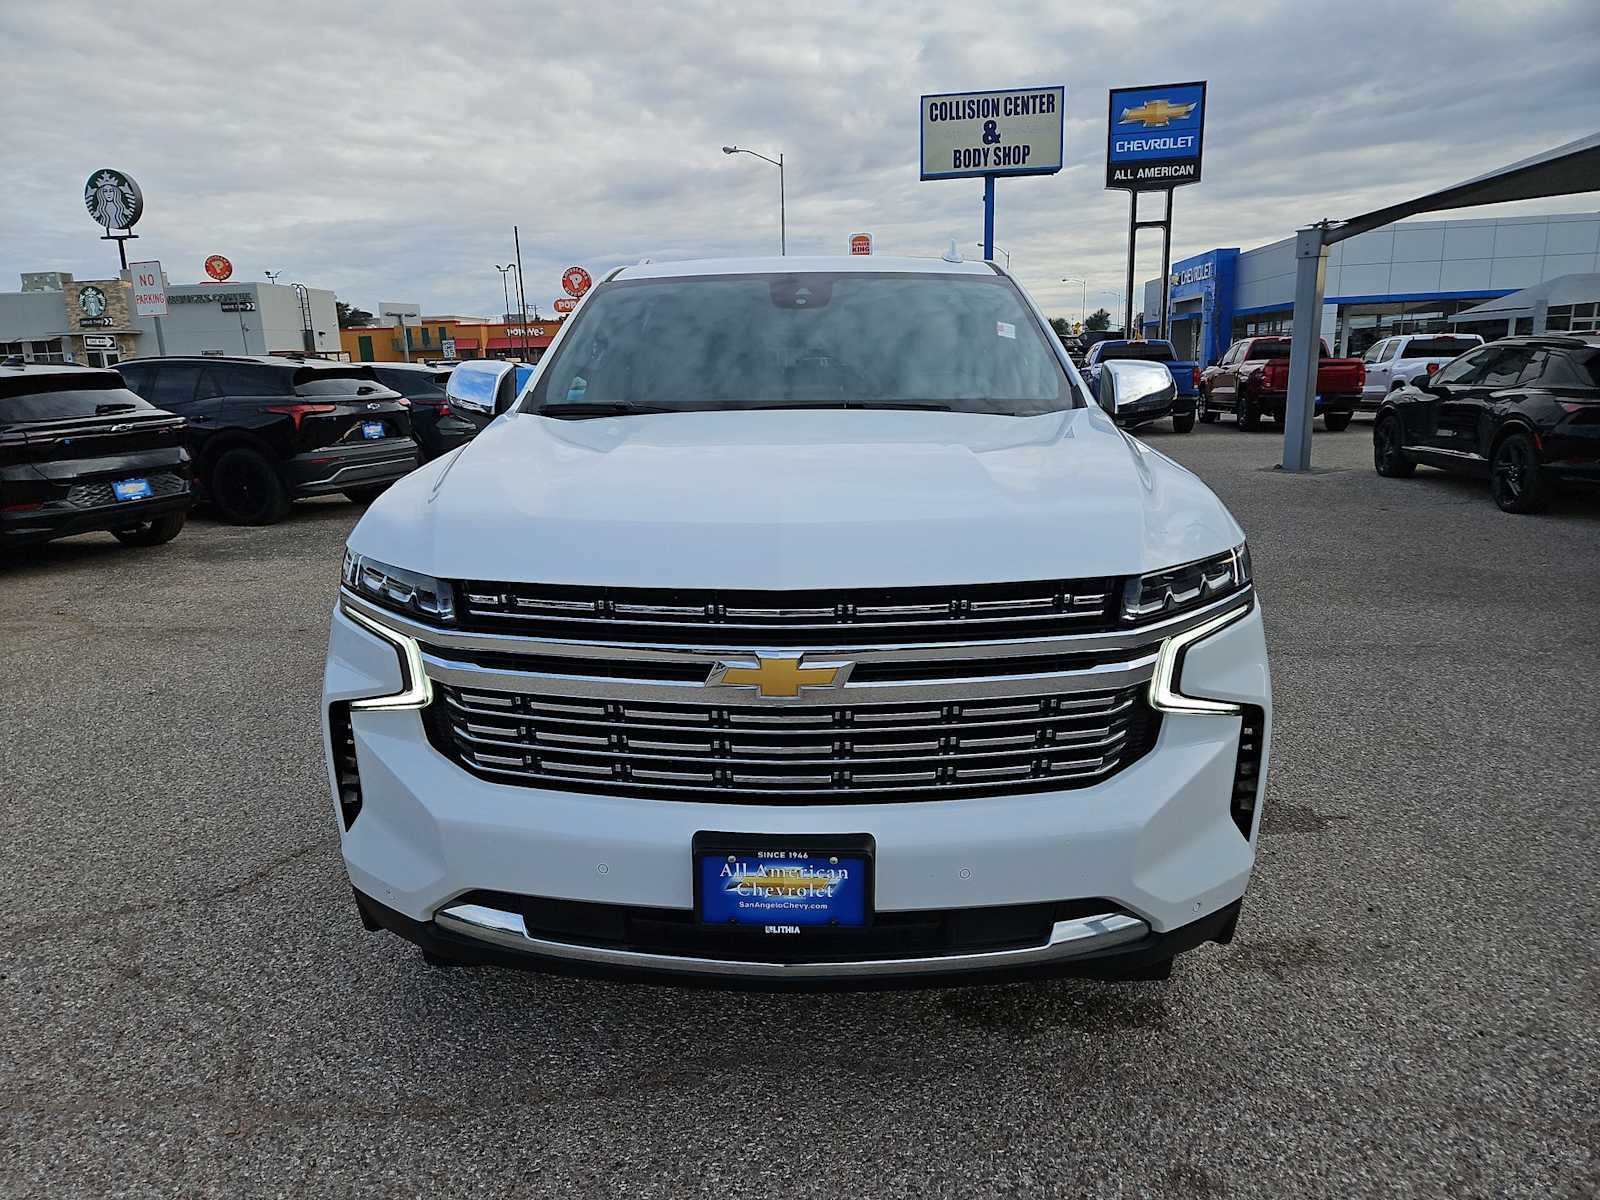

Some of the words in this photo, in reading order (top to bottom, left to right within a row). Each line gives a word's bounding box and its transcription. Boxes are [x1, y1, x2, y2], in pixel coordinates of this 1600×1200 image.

[929, 98, 1000, 122] COLLISION
[1003, 93, 1056, 117] CENTER
[982, 120, 1001, 145] &
[1115, 136, 1194, 153] CHEVROLET
[953, 148, 990, 169] BODY
[993, 144, 1031, 165] SHOP
[1114, 168, 1134, 180] ALL
[1136, 164, 1194, 179] AMERICAN
[139, 273, 155, 287] NO
[135, 293, 166, 305] PARKING
[757, 851, 786, 860] SINCE
[788, 851, 809, 860] 1946
[720, 863, 747, 877] All
[756, 864, 849, 880] American
[737, 883, 833, 898] Chevrolet
[738, 901, 829, 911] SanAngeloChevy.com
[772, 925, 800, 934] LITHIA
